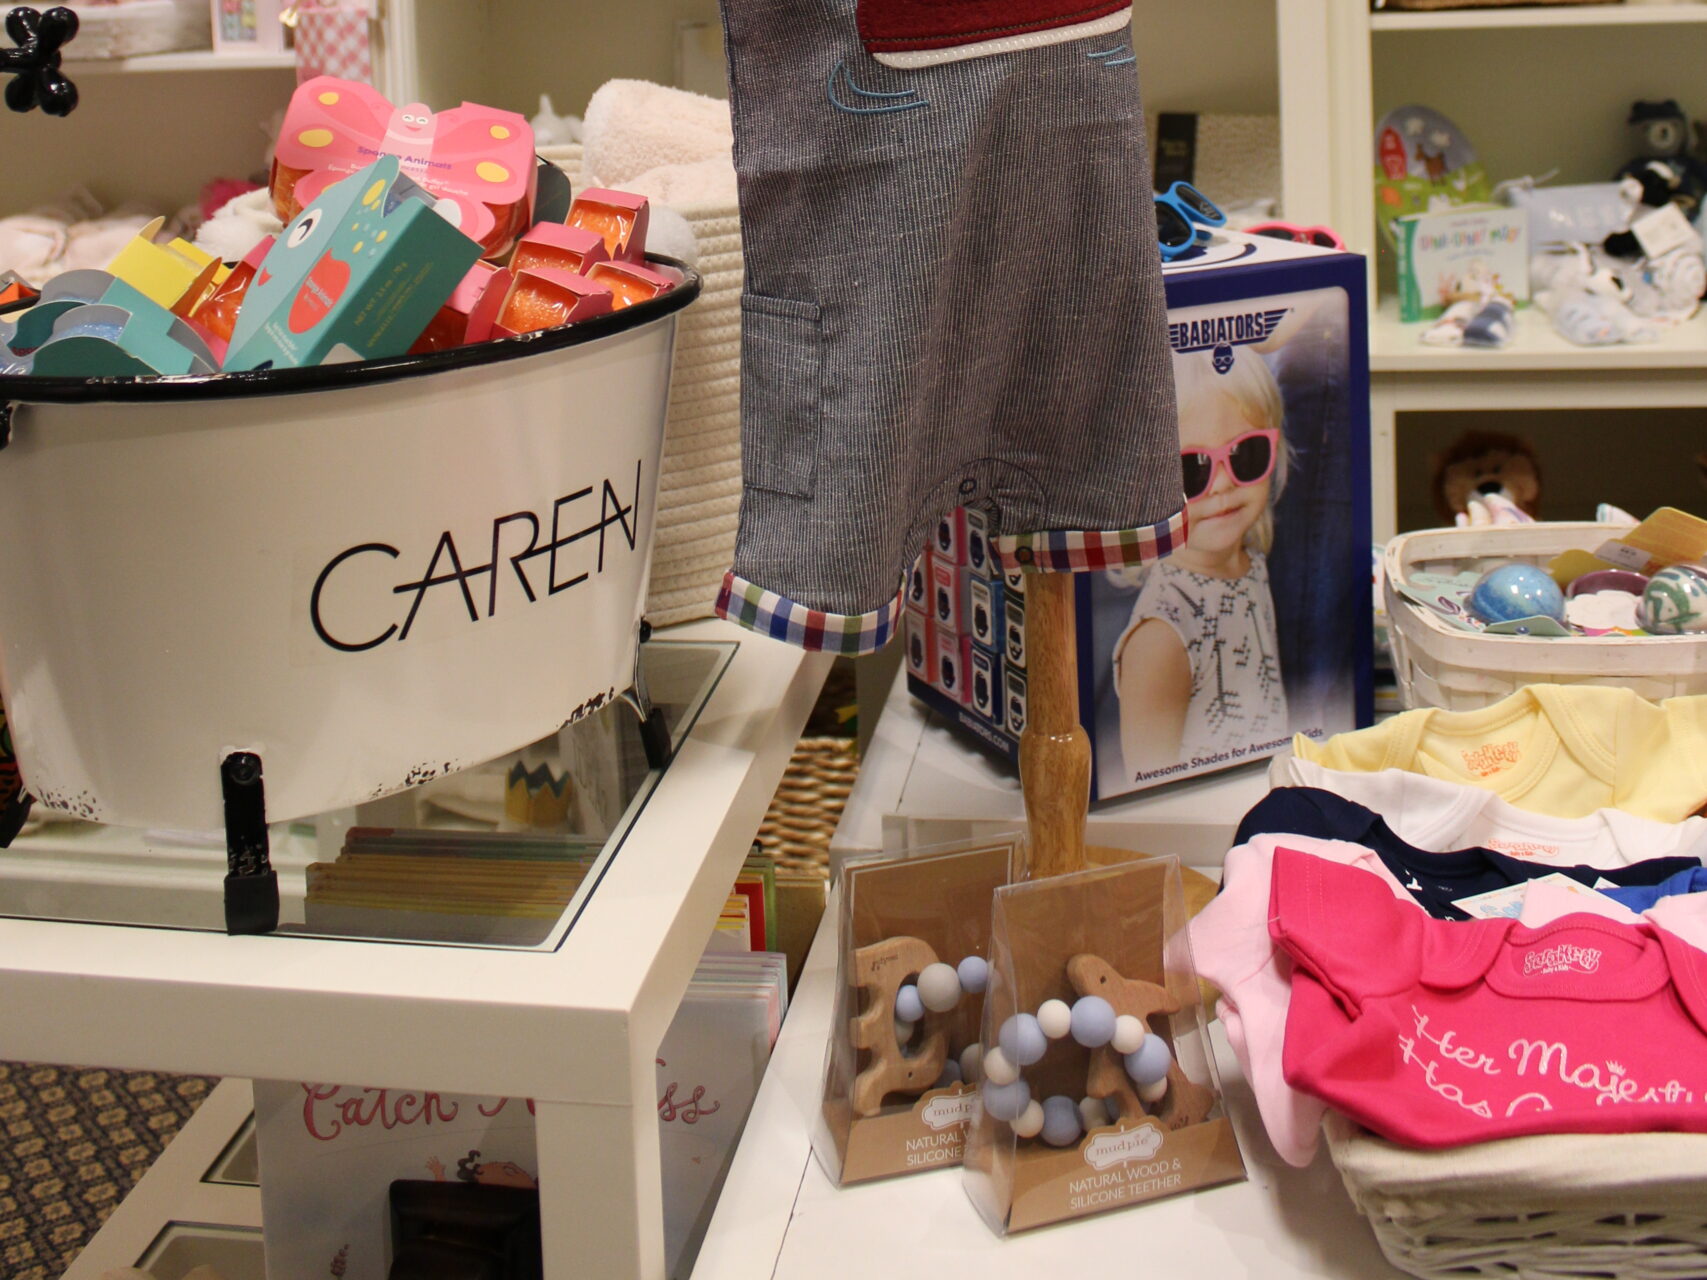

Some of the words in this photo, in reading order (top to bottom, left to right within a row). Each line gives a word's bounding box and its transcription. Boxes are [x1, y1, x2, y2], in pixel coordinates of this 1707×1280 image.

[356, 145, 402, 160] Spone
[404, 155, 453, 170] Animals
[1179, 311, 1266, 348] BABIATORS
[310, 459, 642, 653] CAREN
[1134, 761, 1190, 783] Awesome
[1190, 752, 1230, 769] Shades
[1231, 746, 1247, 759] for
[1248, 736, 1293, 753] Awesom
[301, 1082, 460, 1141] Catch
[657, 1065, 721, 1124] ss
[933, 1103, 975, 1117] mudp
[905, 1130, 961, 1152] NATURAL
[907, 1145, 962, 1167] SILICONE
[1069, 1171, 1125, 1194] NATURAL
[1126, 1160, 1169, 1181] WOOD
[1172, 1157, 1182, 1170] &
[1070, 1187, 1125, 1210] SILICONE
[1128, 1174, 1182, 1196] TEETHER
